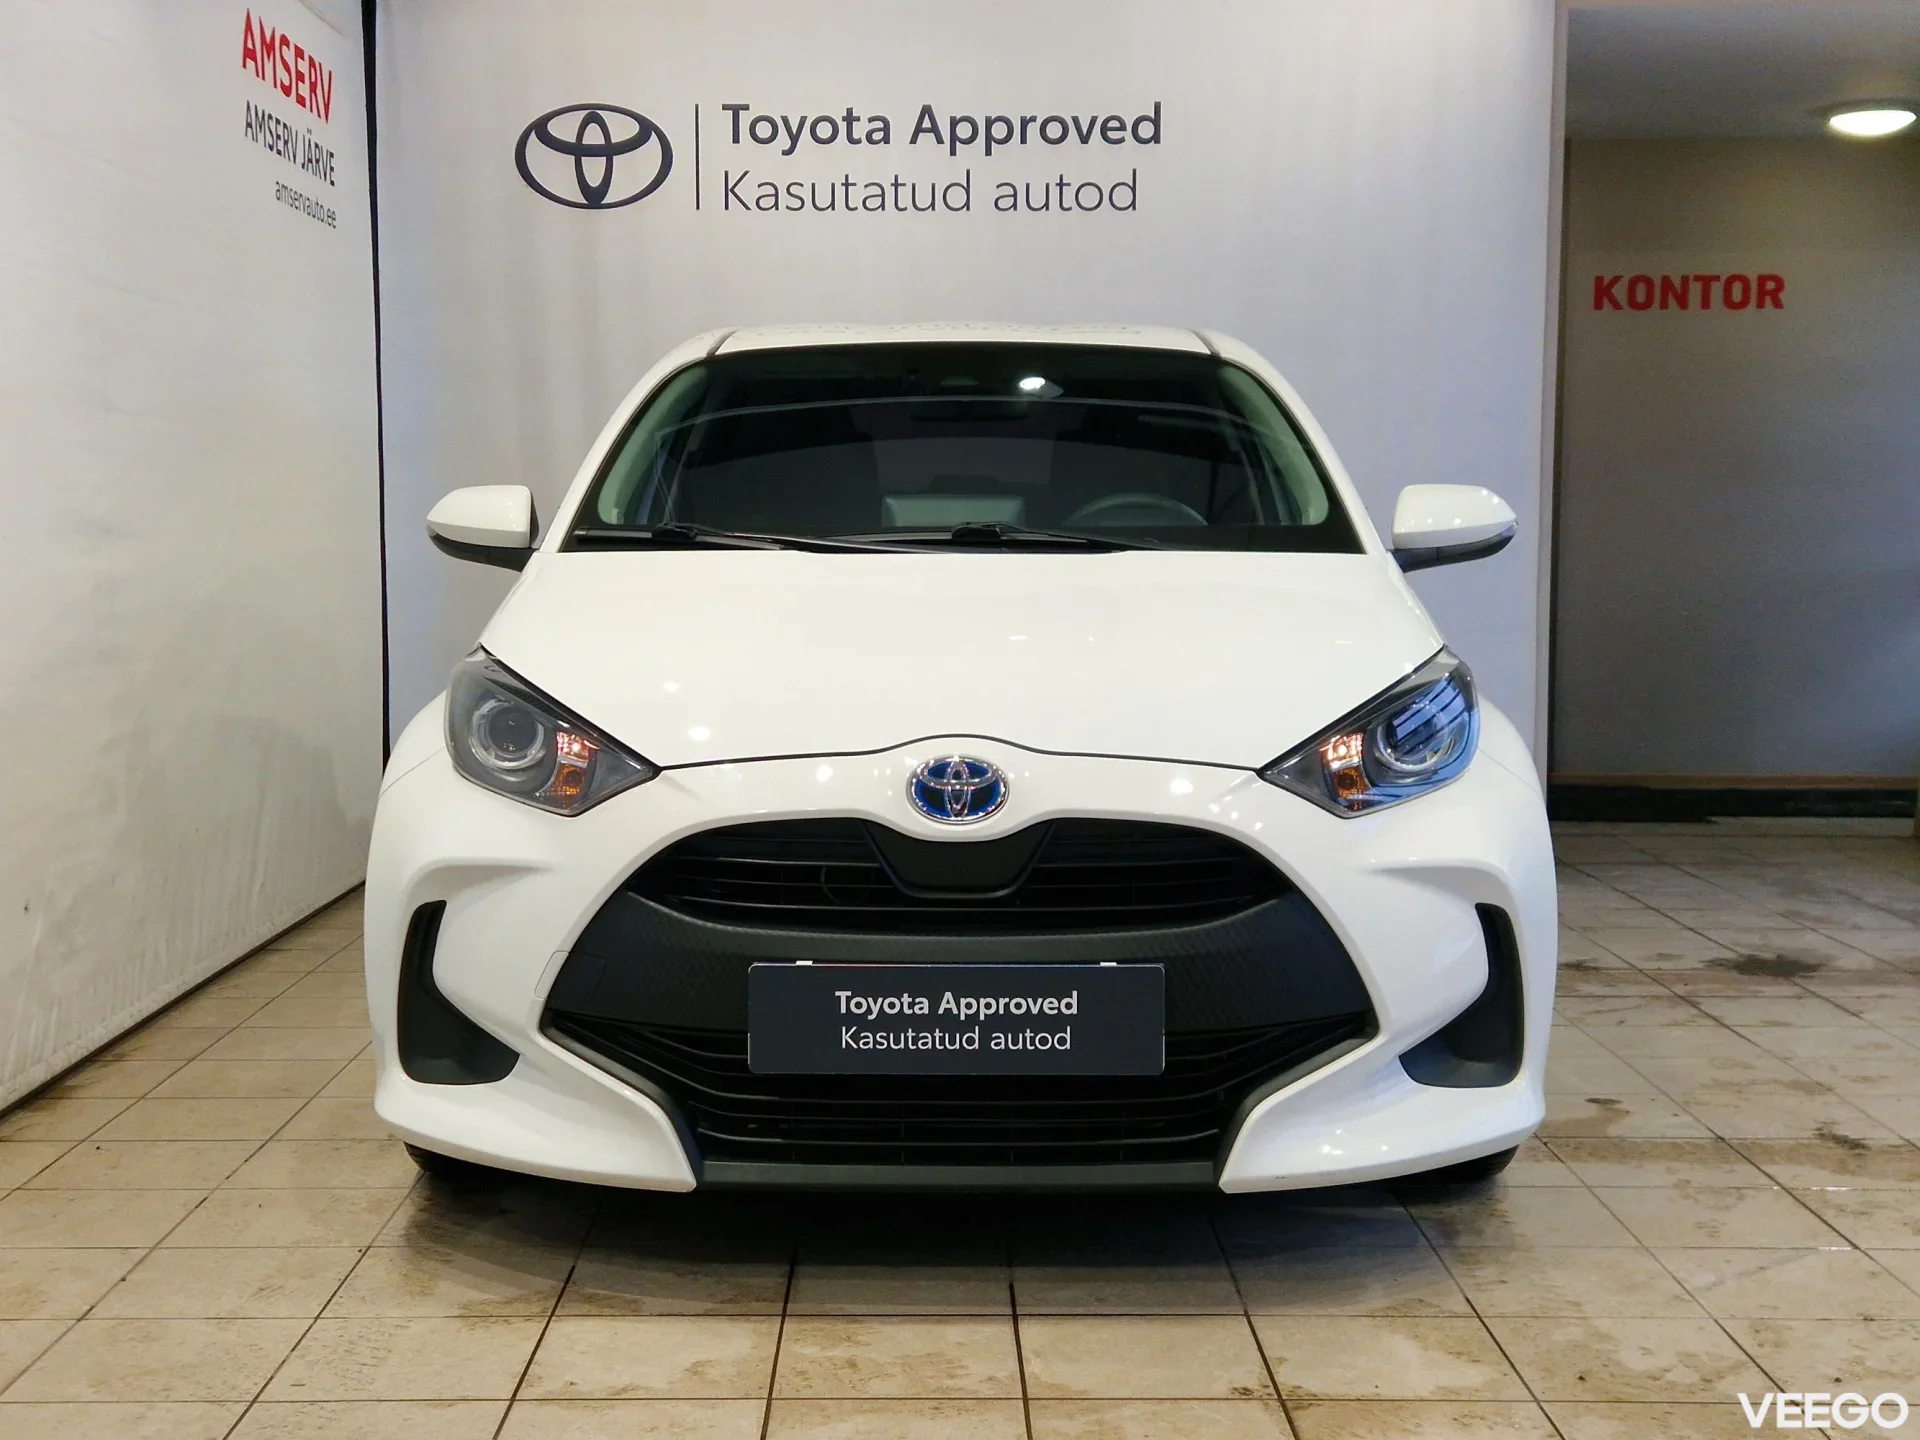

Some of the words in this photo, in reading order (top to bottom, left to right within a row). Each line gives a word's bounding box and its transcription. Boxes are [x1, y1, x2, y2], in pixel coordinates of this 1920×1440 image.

[242, 7, 333, 125] AMSERV
[244, 99, 299, 165] AMSERV
[300, 127, 336, 187] JÄRVE
[721, 104, 892, 156] Toyota
[909, 102, 1163, 156] Approved
[275, 180, 337, 229] amservauto.ee
[723, 169, 972, 212] Kasutatud
[993, 169, 1139, 212] autod
[1593, 273, 1786, 311] KONTOR
[834, 990, 931, 1020] Toyota
[937, 990, 1079, 1021] Approved
[841, 1025, 980, 1050] Kasutatud
[989, 1025, 1072, 1050] autod
